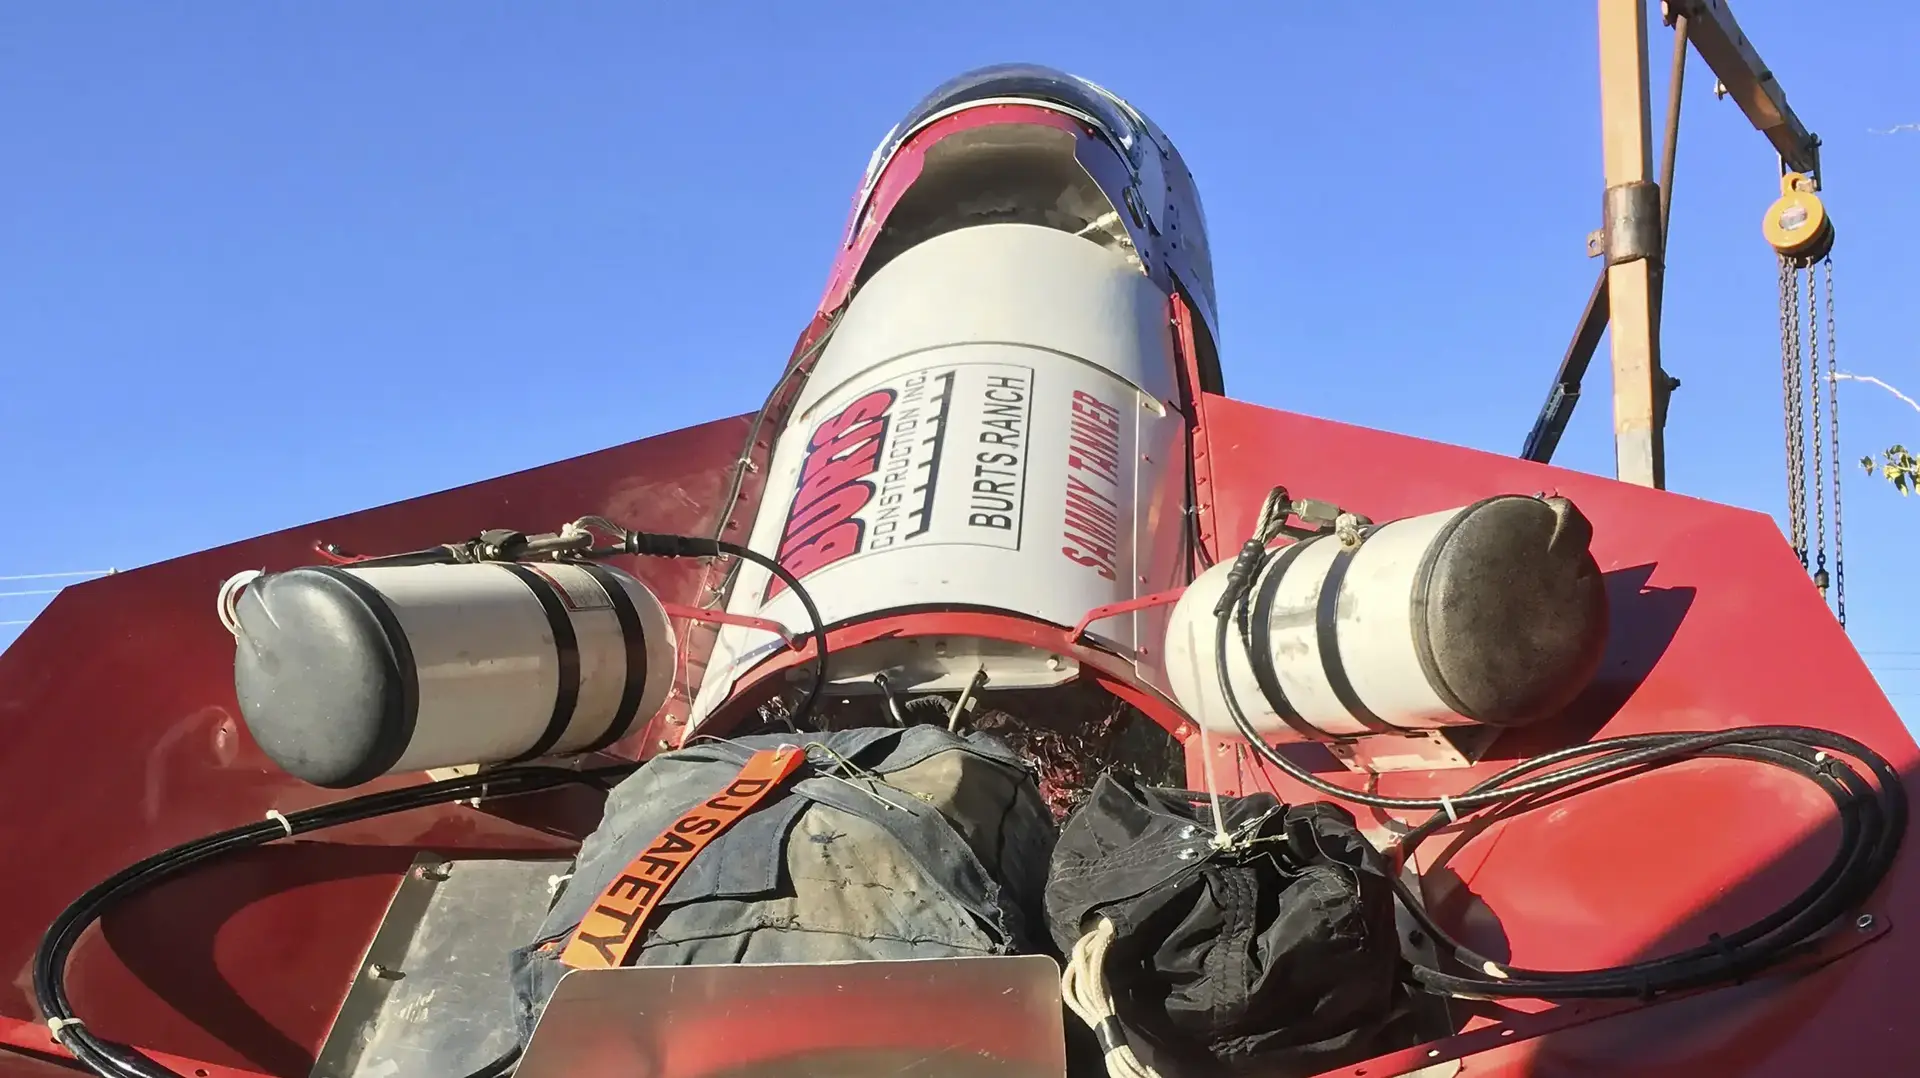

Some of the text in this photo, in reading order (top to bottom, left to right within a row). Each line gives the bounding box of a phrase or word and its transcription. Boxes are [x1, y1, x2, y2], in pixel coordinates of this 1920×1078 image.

[760, 388, 899, 608] BURTS
[870, 370, 928, 550] CONSTRUCTION INC.
[969, 375, 1025, 530] BURTS RANCH
[1062, 390, 1120, 581] SAMMY TANNER
[578, 778, 772, 967] DJ SAFETY
